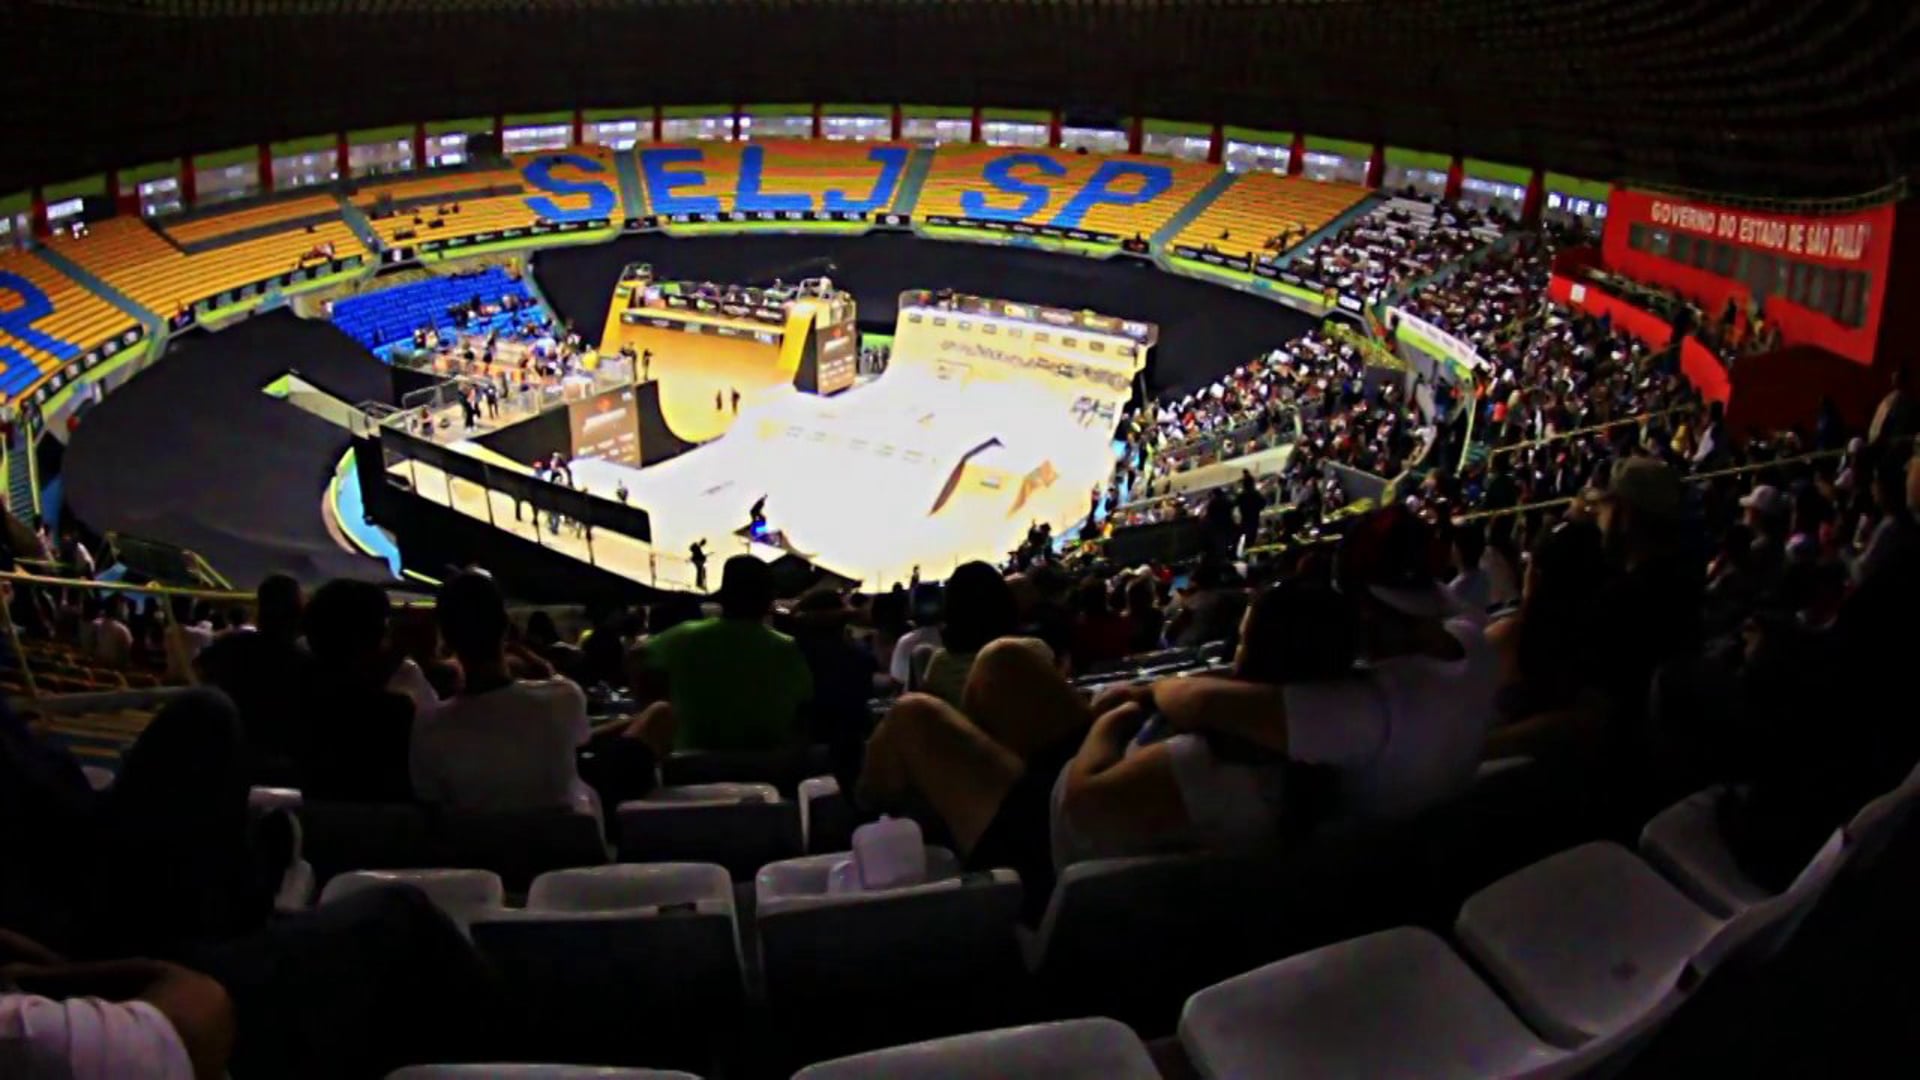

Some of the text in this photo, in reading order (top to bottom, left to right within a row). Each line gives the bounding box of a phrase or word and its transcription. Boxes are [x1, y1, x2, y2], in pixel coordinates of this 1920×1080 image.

[961, 153, 1173, 229] SP
[1651, 201, 1868, 261] GOVERNO DO ESTADO DE SÃO PAULO
